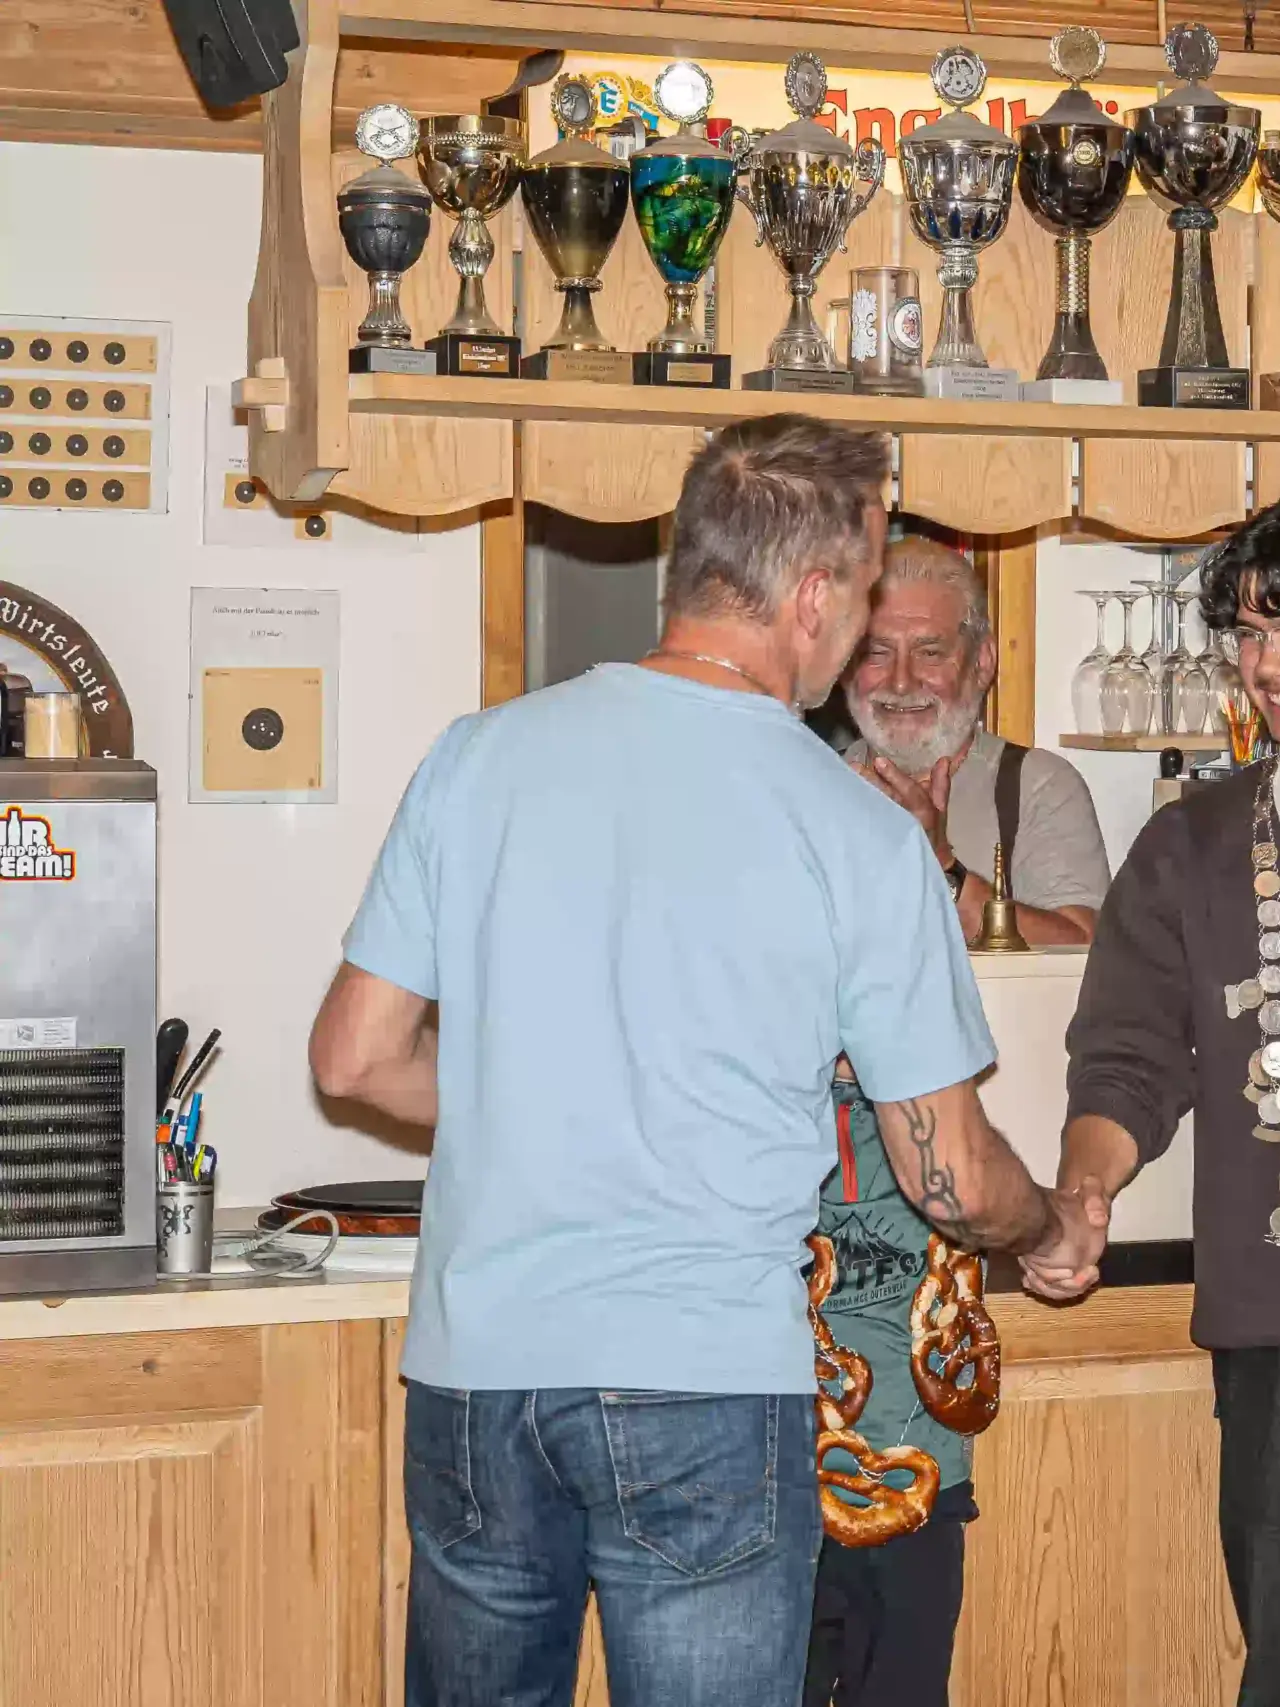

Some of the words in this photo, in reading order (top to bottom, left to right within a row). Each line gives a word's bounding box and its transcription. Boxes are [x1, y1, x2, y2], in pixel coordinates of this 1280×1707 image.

[0, 597, 109, 714] Wirtsleute
[0, 810, 48, 847] IR
[0, 854, 72, 878] EAM!
[27, 845, 53, 857] DAS
